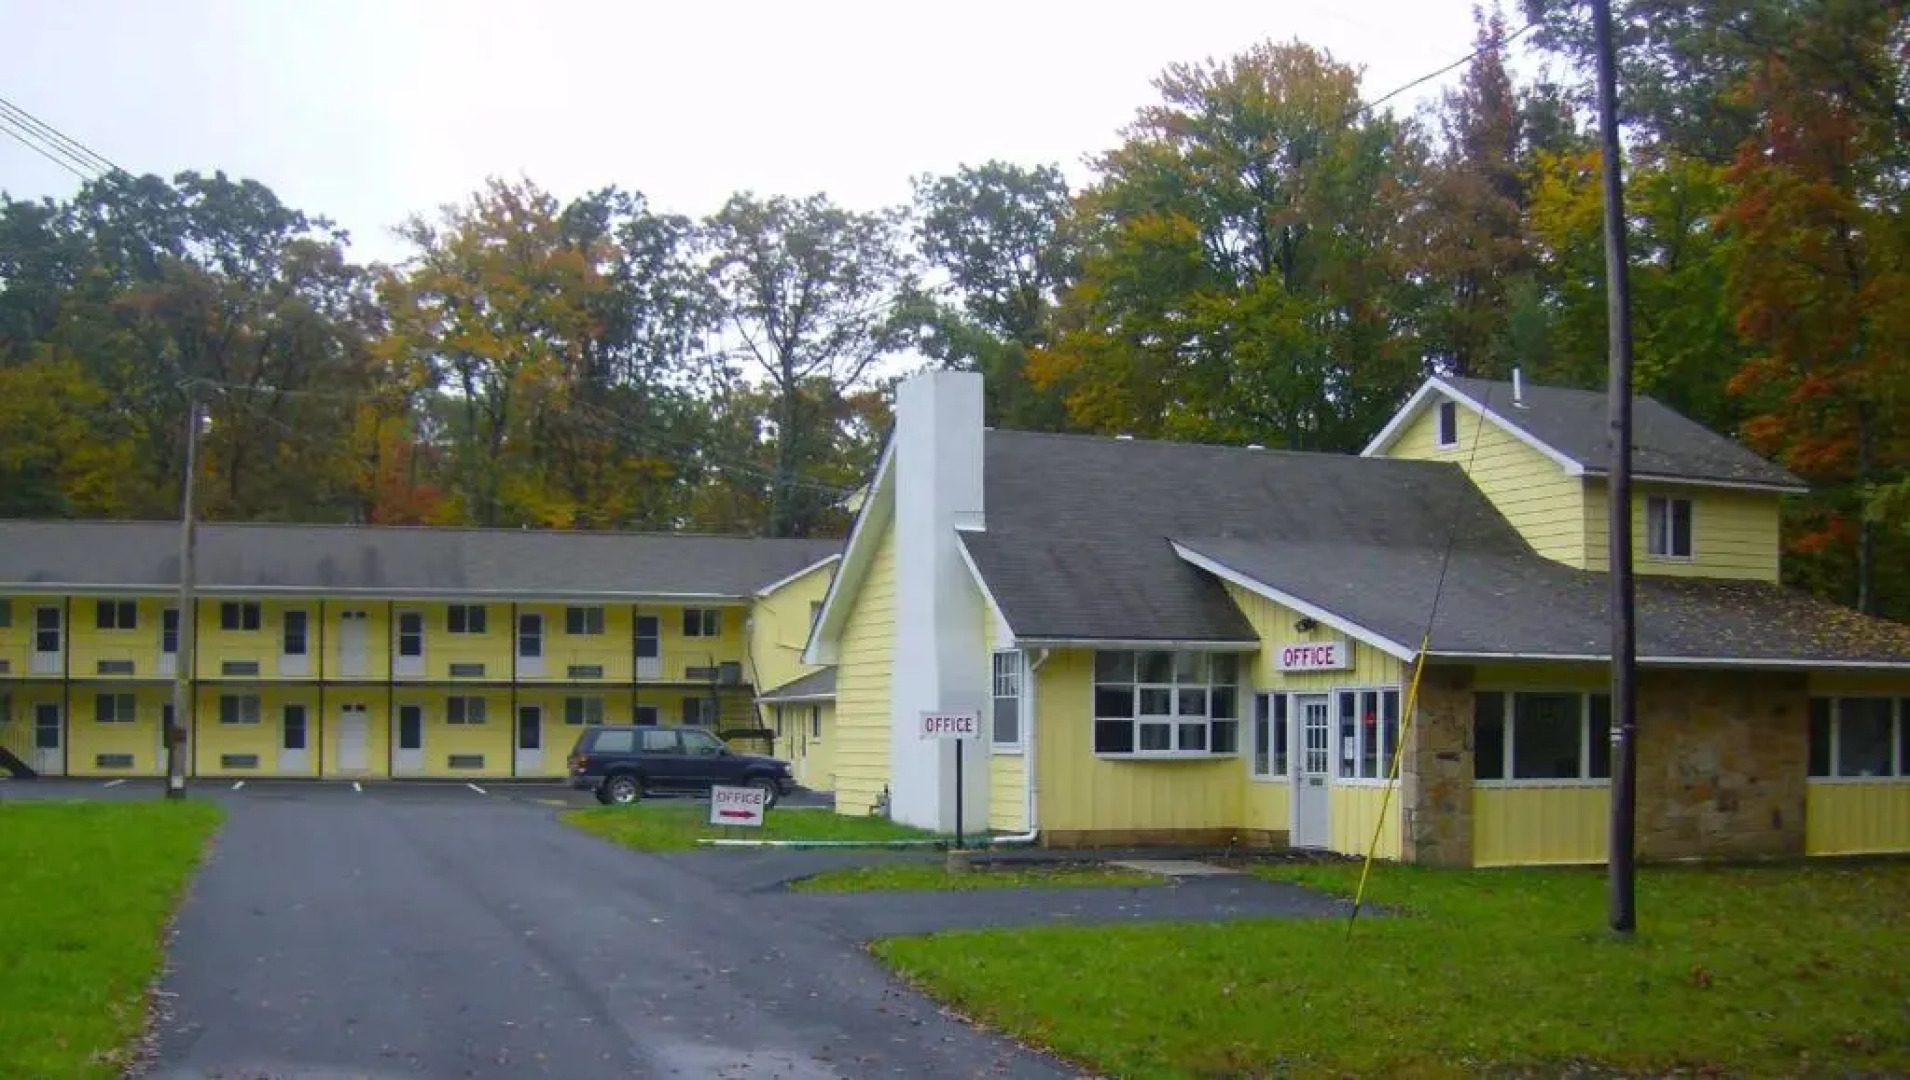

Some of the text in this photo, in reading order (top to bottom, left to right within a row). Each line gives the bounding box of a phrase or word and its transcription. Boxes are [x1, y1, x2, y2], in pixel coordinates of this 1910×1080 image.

[1283, 646, 1335, 667] OFFICE
[925, 717, 973, 732] OFFICE
[716, 790, 762, 805] OFFICE
